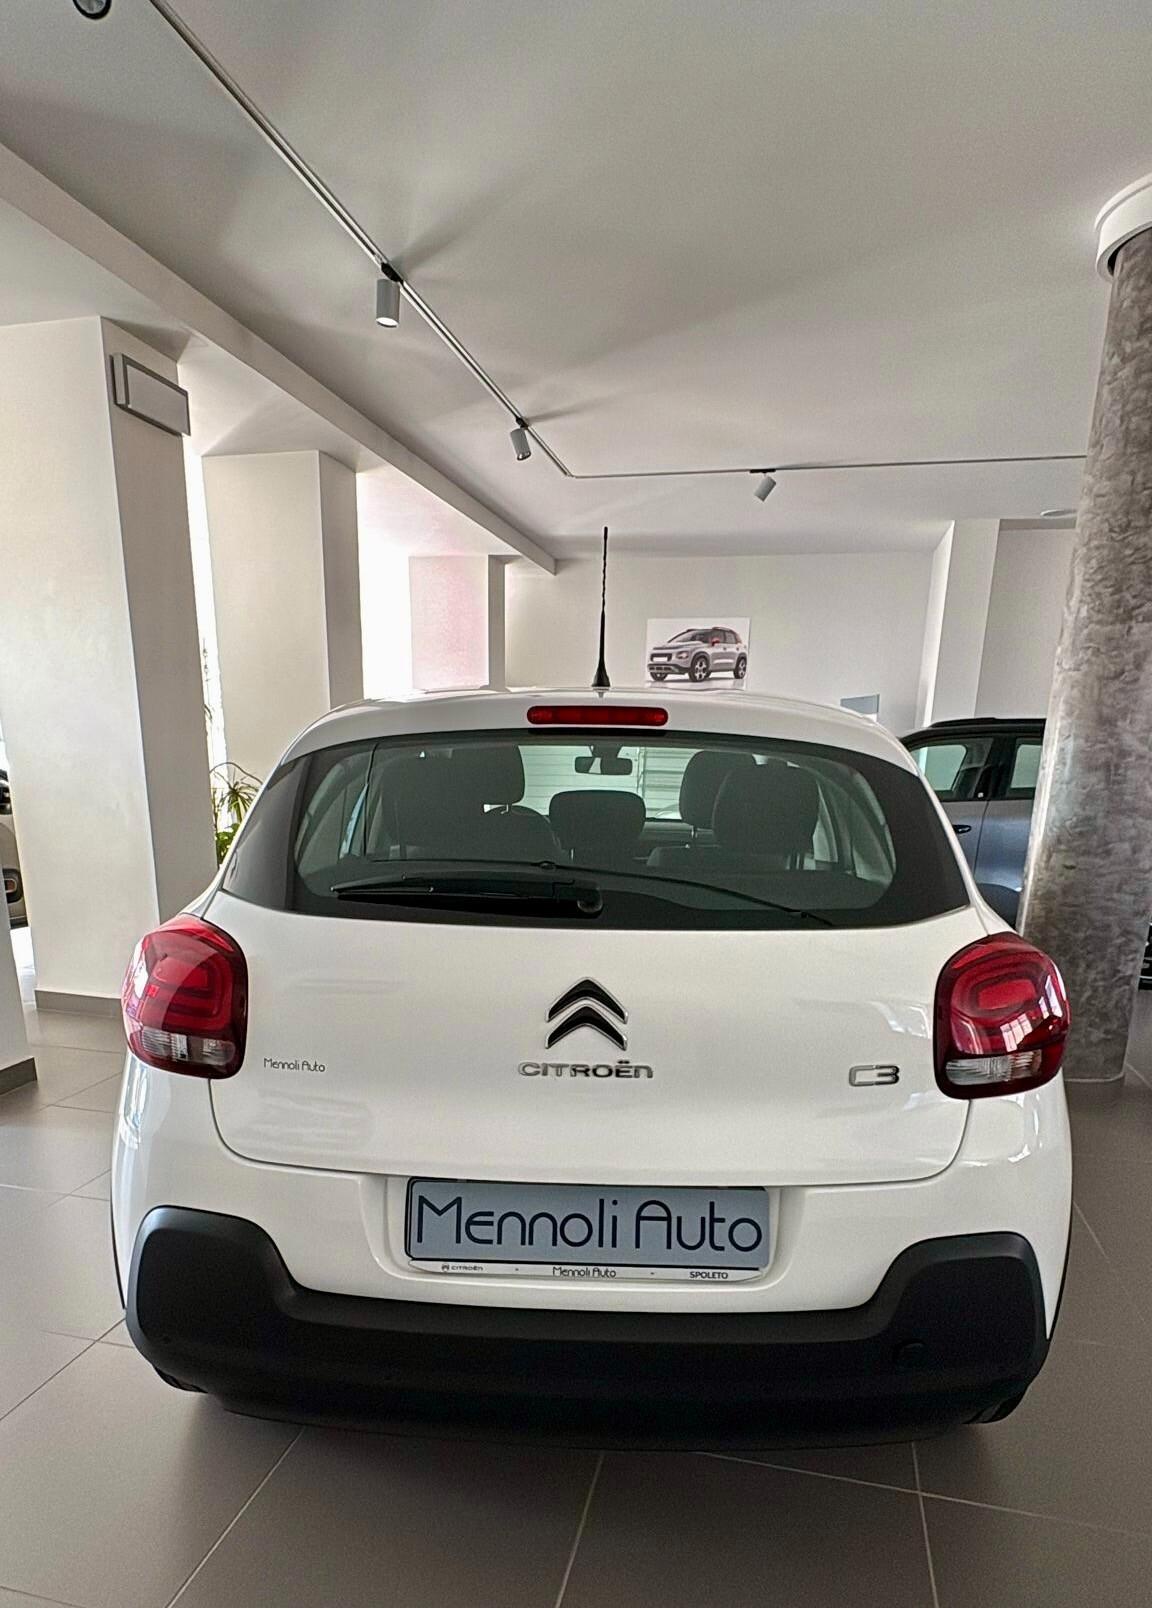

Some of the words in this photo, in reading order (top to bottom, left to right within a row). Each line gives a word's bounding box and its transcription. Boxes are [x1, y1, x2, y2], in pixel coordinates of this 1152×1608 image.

[263, 1057, 300, 1070] Mennoli
[302, 1060, 326, 1072] Auto
[848, 1064, 900, 1087] C3
[417, 1195, 618, 1248] Mennoli
[635, 1200, 762, 1252] Auto
[552, 1266, 591, 1278] Mennoli
[592, 1268, 617, 1278] Auto
[689, 1271, 728, 1280] SPOLETO
